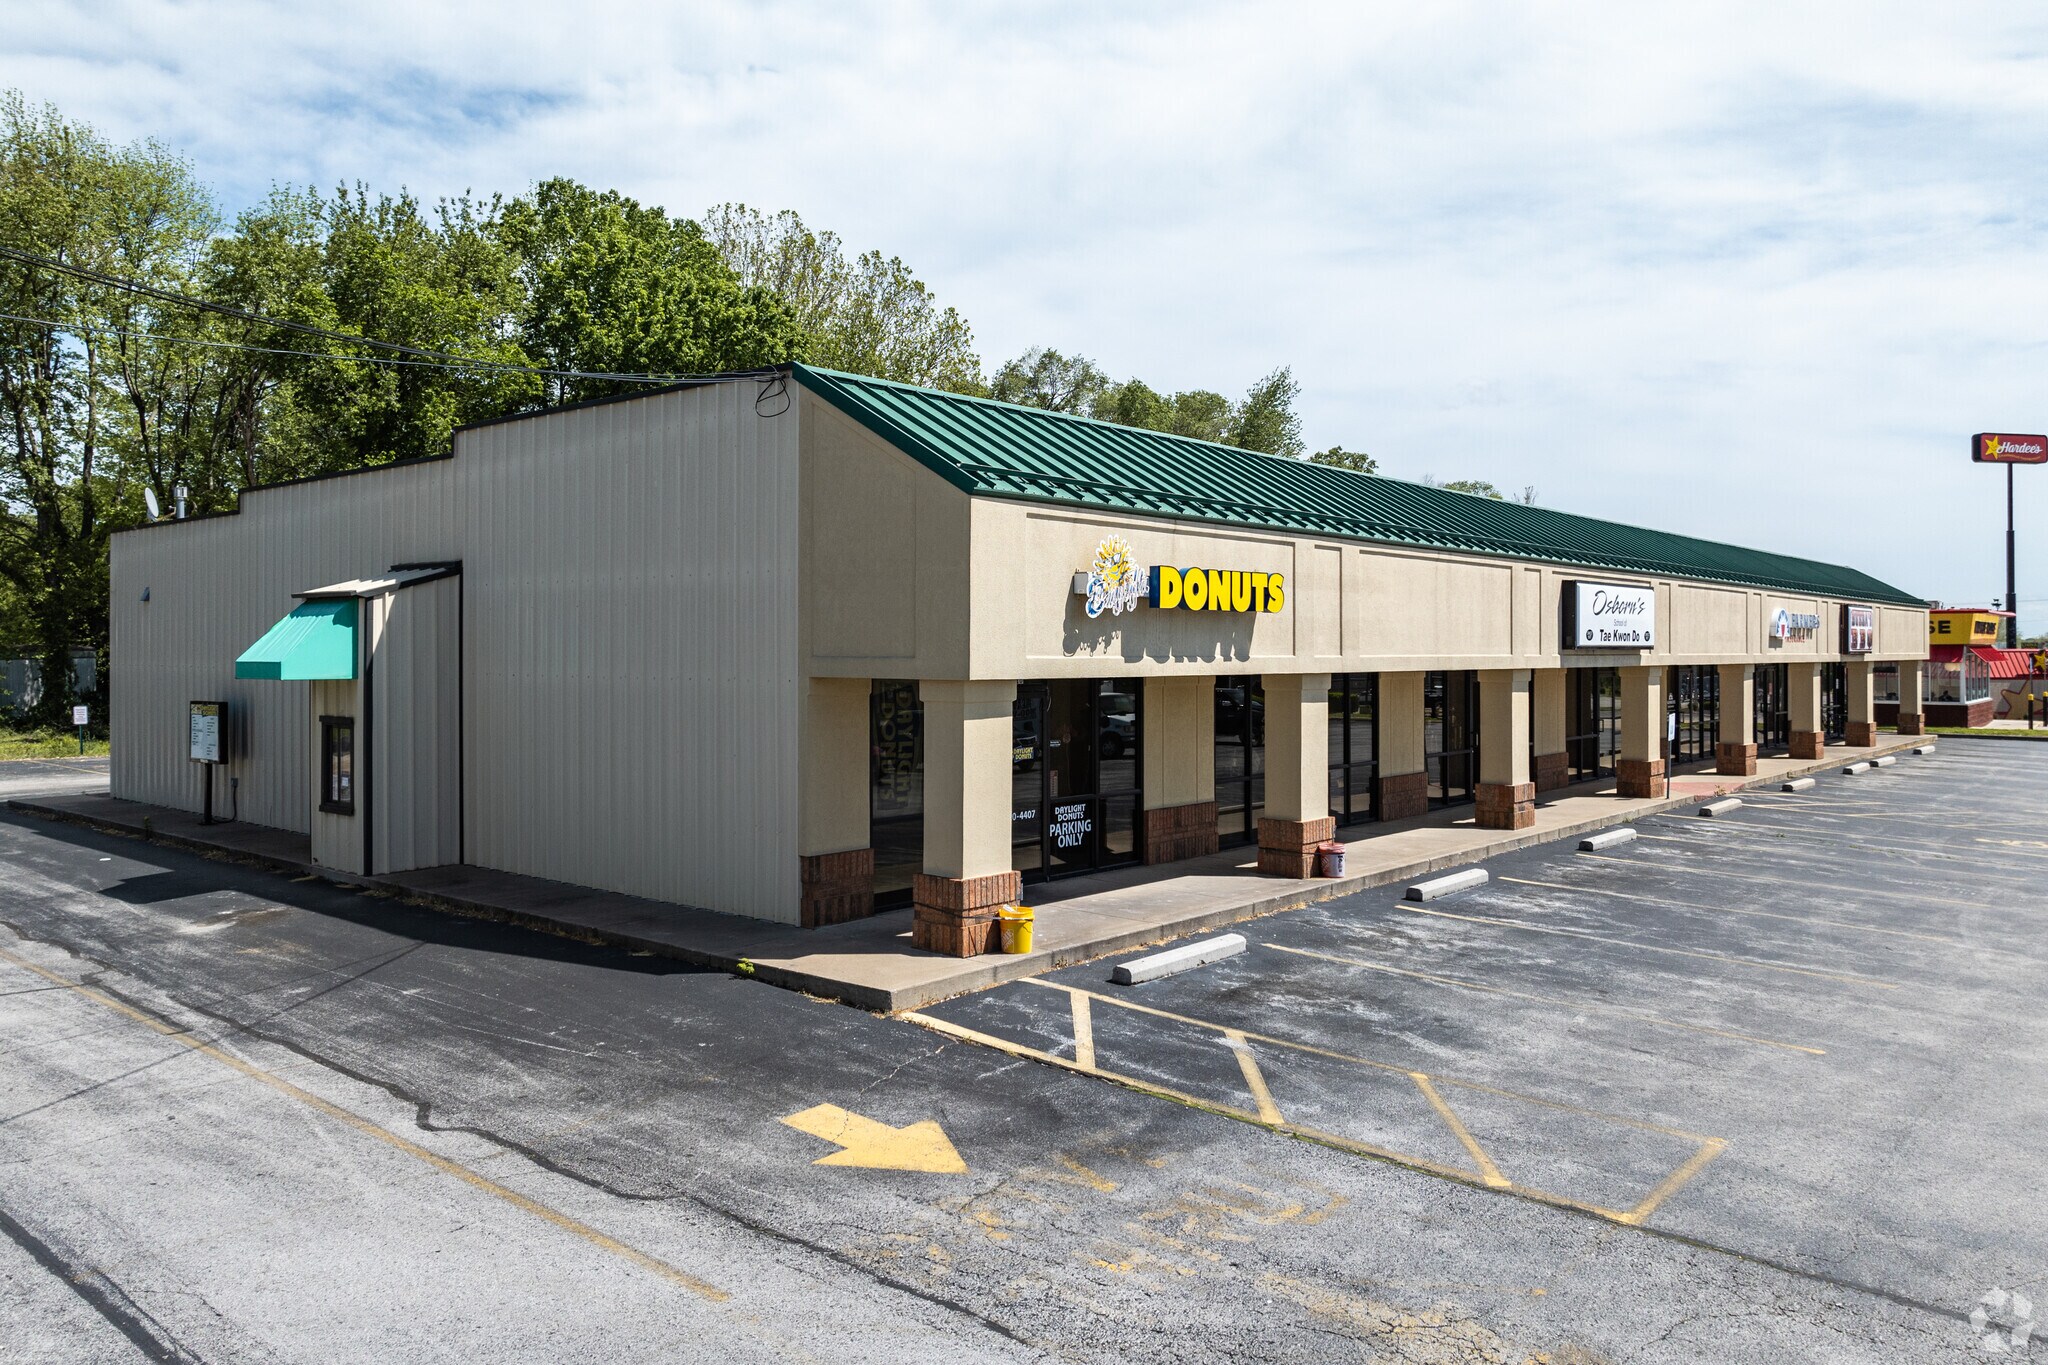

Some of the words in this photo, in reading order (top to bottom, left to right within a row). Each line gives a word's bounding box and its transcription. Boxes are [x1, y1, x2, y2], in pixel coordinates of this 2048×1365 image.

[1996, 441, 2043, 454] Hardee's
[1158, 565, 1285, 613] DONUTS
[1593, 590, 1645, 616] Osborn's
[1600, 629, 1611, 642] Tae
[1613, 629, 1631, 642] Kwon
[1632, 630, 1640, 642] Do
[1055, 803, 1086, 815] DAYLIGHT
[1057, 811, 1084, 822] DONUTS
[1049, 819, 1092, 837] PARKING
[1057, 832, 1084, 848] ONLY
